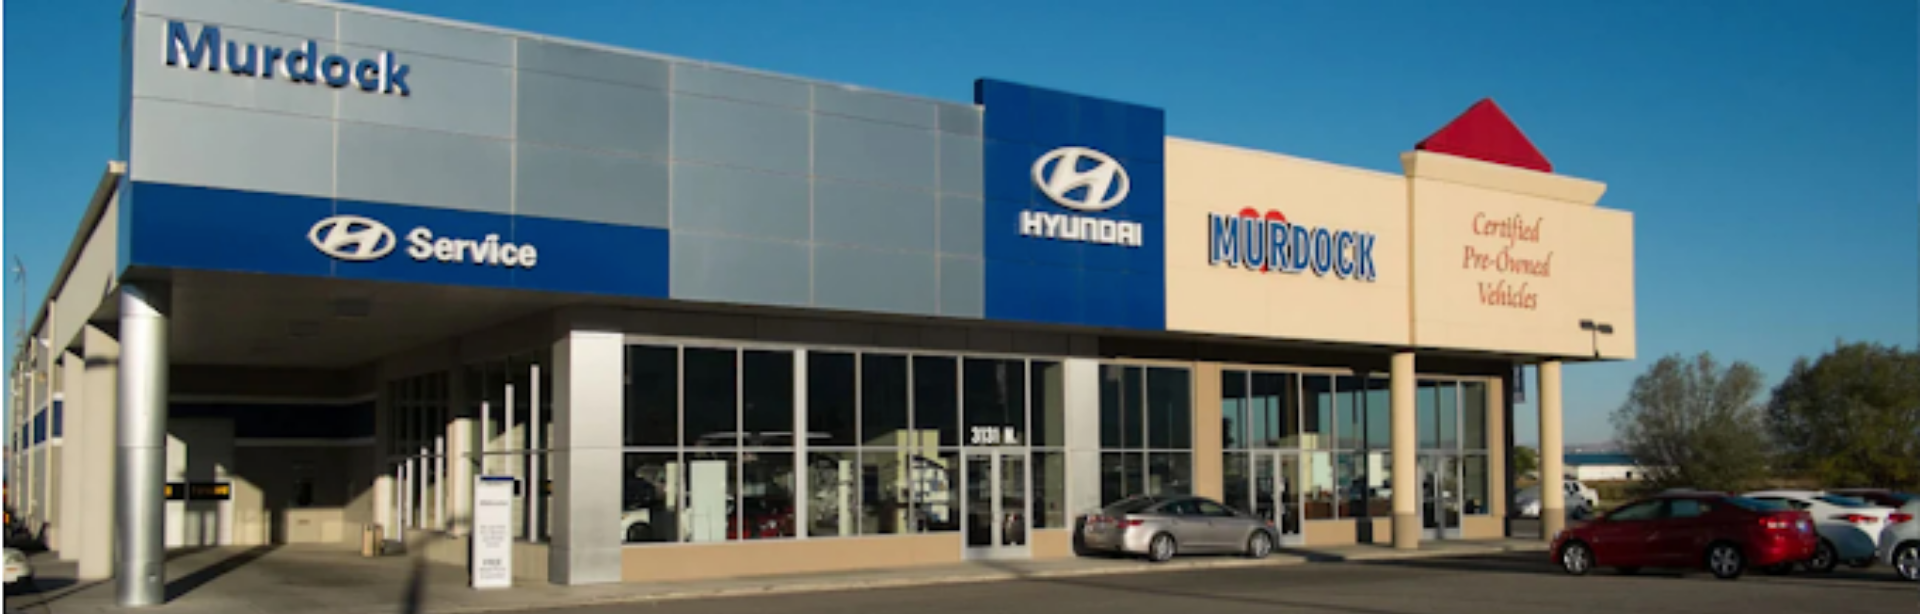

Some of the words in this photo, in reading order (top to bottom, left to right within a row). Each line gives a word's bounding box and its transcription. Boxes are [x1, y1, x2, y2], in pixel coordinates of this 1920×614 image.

[163, 20, 412, 97] Murdock
[406, 226, 538, 267] Service
[1019, 210, 1142, 247] HYUNDAI
[1208, 212, 1377, 281] MURDOCK
[1472, 211, 1544, 247] Certified
[1462, 245, 1553, 277] Pre-Owned
[1477, 279, 1538, 310] Vehicles
